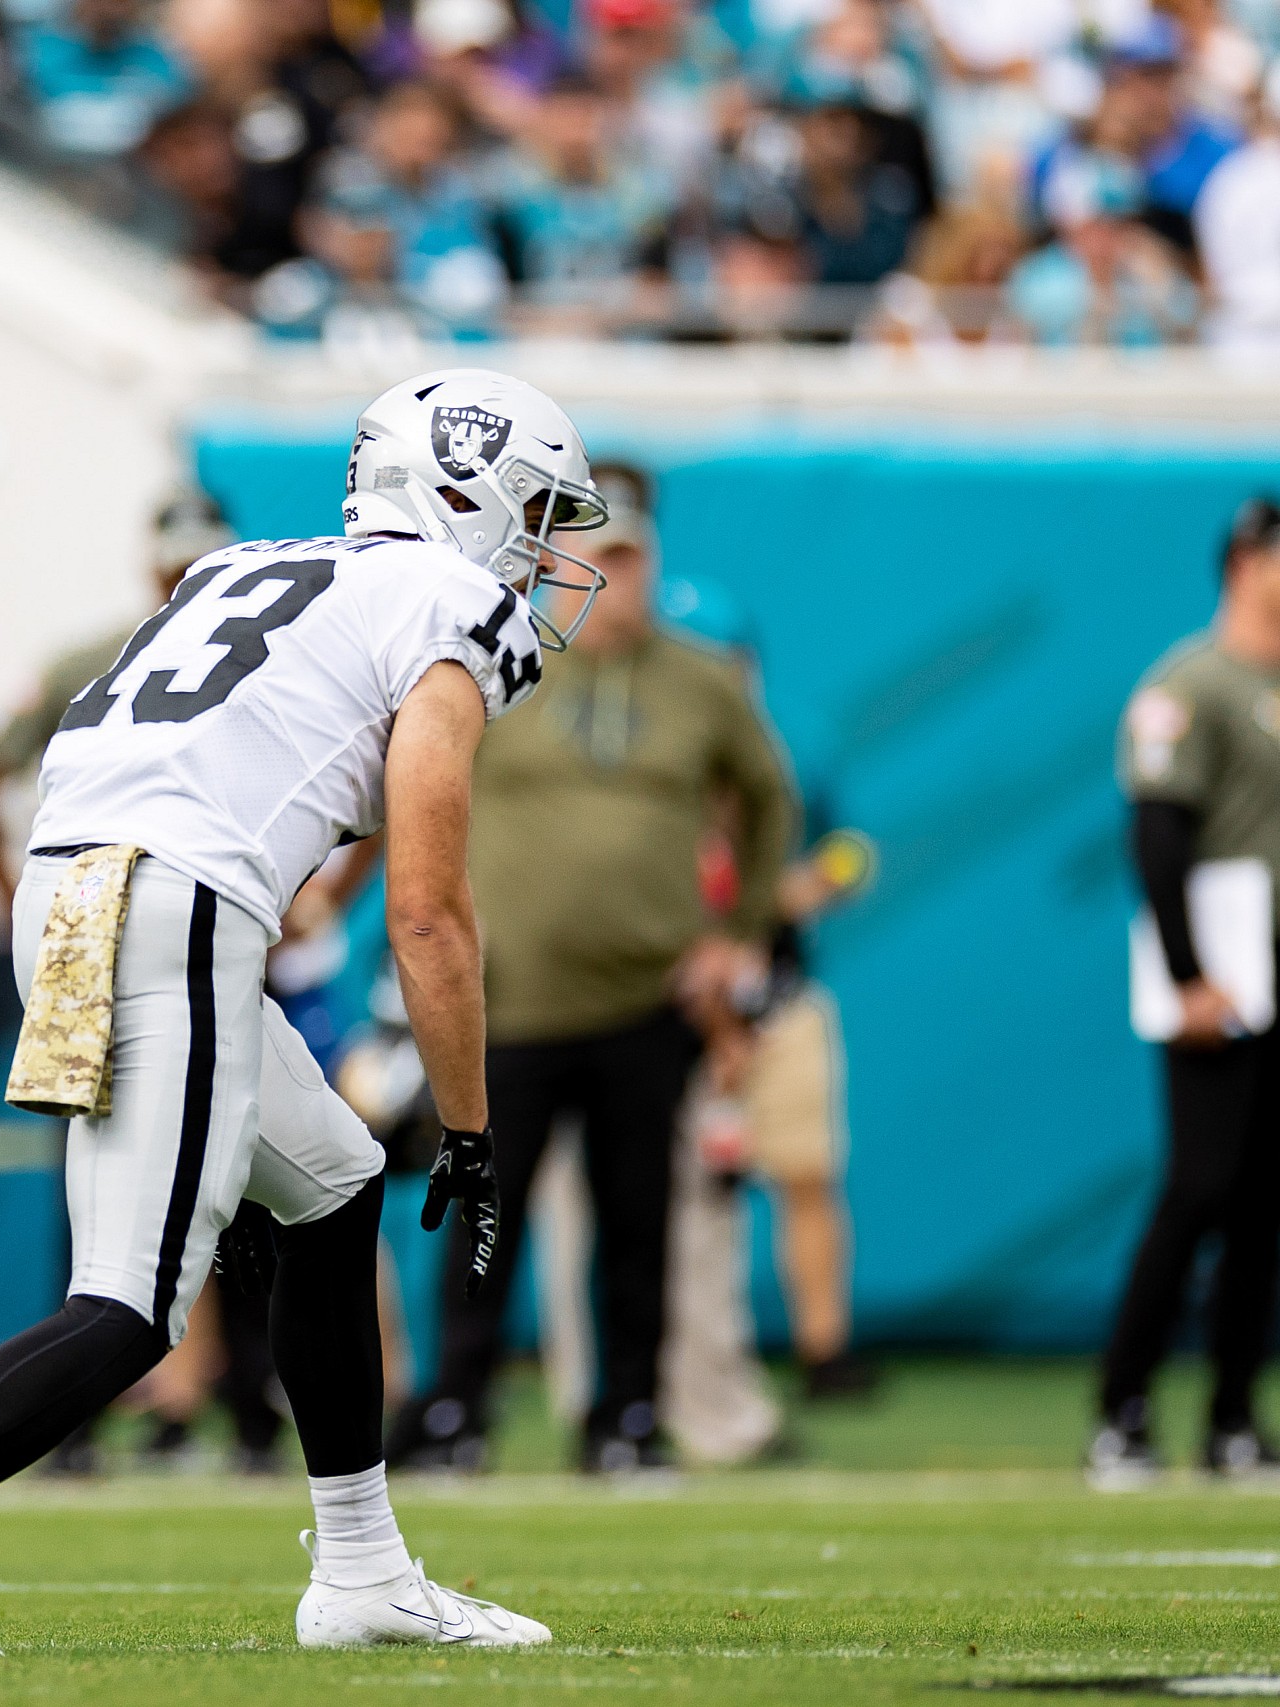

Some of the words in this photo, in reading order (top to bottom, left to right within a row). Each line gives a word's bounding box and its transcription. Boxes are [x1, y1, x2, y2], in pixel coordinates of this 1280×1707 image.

[440, 407, 506, 428] RAIDERS
[58, 558, 336, 731] 13
[467, 583, 542, 703] 13
[473, 1201, 496, 1276] VAPOR
